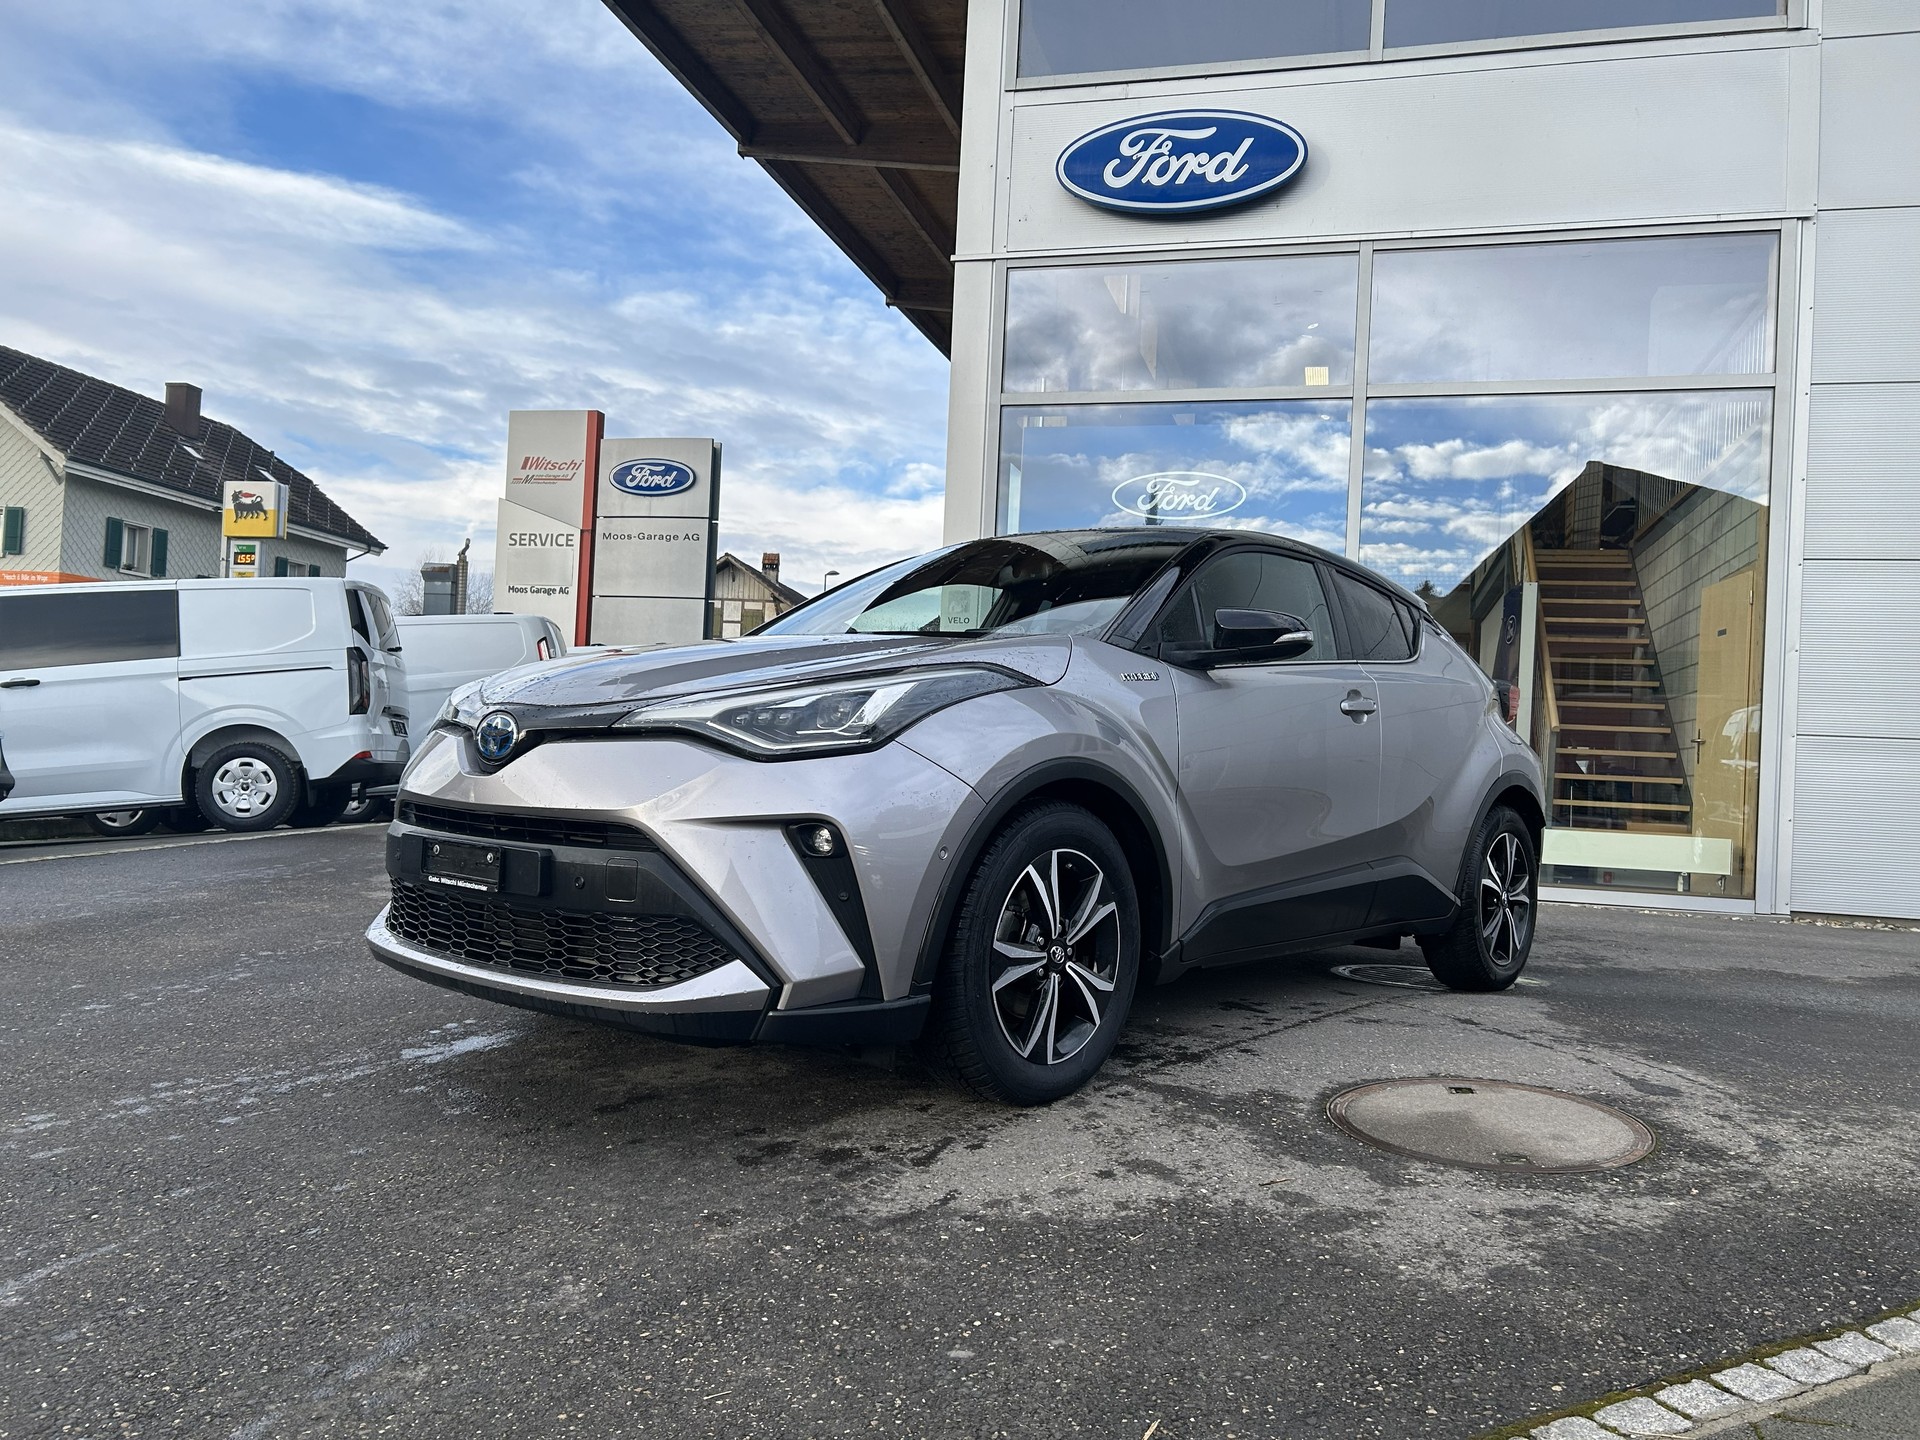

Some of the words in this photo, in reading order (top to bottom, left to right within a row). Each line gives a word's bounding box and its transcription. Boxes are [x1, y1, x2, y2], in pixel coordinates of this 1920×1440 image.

[1103, 126, 1255, 188] Ford
[527, 456, 585, 471] Witschi
[625, 464, 678, 487] Ford
[1137, 478, 1221, 511] Ford
[508, 532, 575, 547] SERVICE
[602, 532, 680, 543] Moos-Garage
[683, 533, 700, 542] AG
[508, 585, 528, 594] Moos
[530, 586, 557, 596] Garage
[558, 586, 570, 595] AG
[947, 616, 970, 624] VELO
